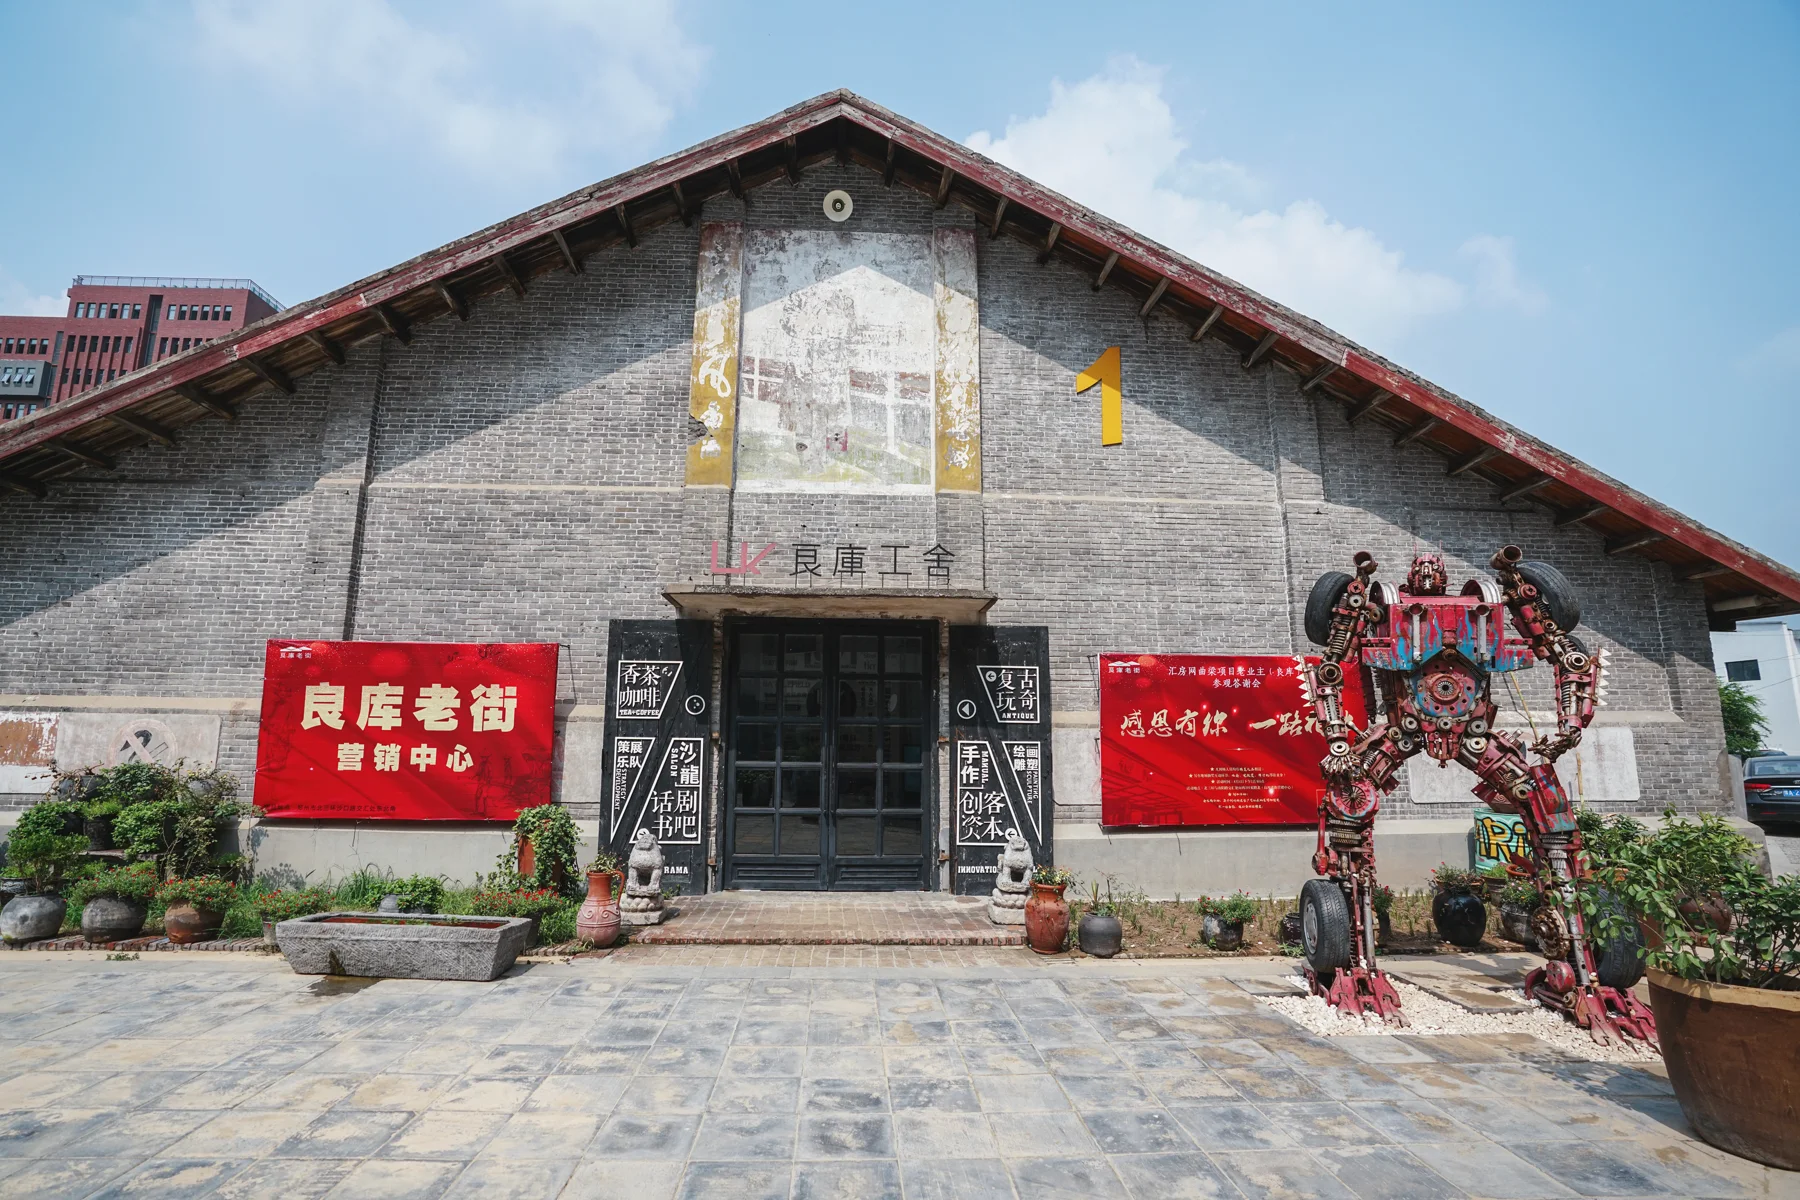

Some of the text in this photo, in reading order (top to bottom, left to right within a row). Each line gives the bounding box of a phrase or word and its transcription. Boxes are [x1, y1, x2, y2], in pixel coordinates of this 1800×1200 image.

[1076, 346, 1122, 446] 1
[711, 541, 778, 575] LK
[620, 663, 661, 686] 香茶
[996, 669, 1037, 690] 复古
[1212, 678, 1262, 688] 参观答谢会
[301, 681, 518, 733] 良库老街
[619, 686, 661, 708] 咖啡
[996, 689, 1037, 712] 玩奇
[1120, 709, 1228, 738] 感恩有你
[336, 742, 474, 774] 营销中心
[617, 740, 643, 754] 策展
[1013, 745, 1038, 758] 绘画
[616, 755, 642, 768] 乐队
[670, 748, 679, 777] SALON
[960, 745, 980, 784] 手作
[981, 750, 989, 784] MANUAL
[651, 790, 698, 814] 话剧
[959, 790, 1006, 815] 创客
[651, 815, 698, 840] 书吧
[960, 815, 1005, 841] 资本
[663, 866, 689, 874] RAMA
[957, 866, 998, 874] INNOVATIO
